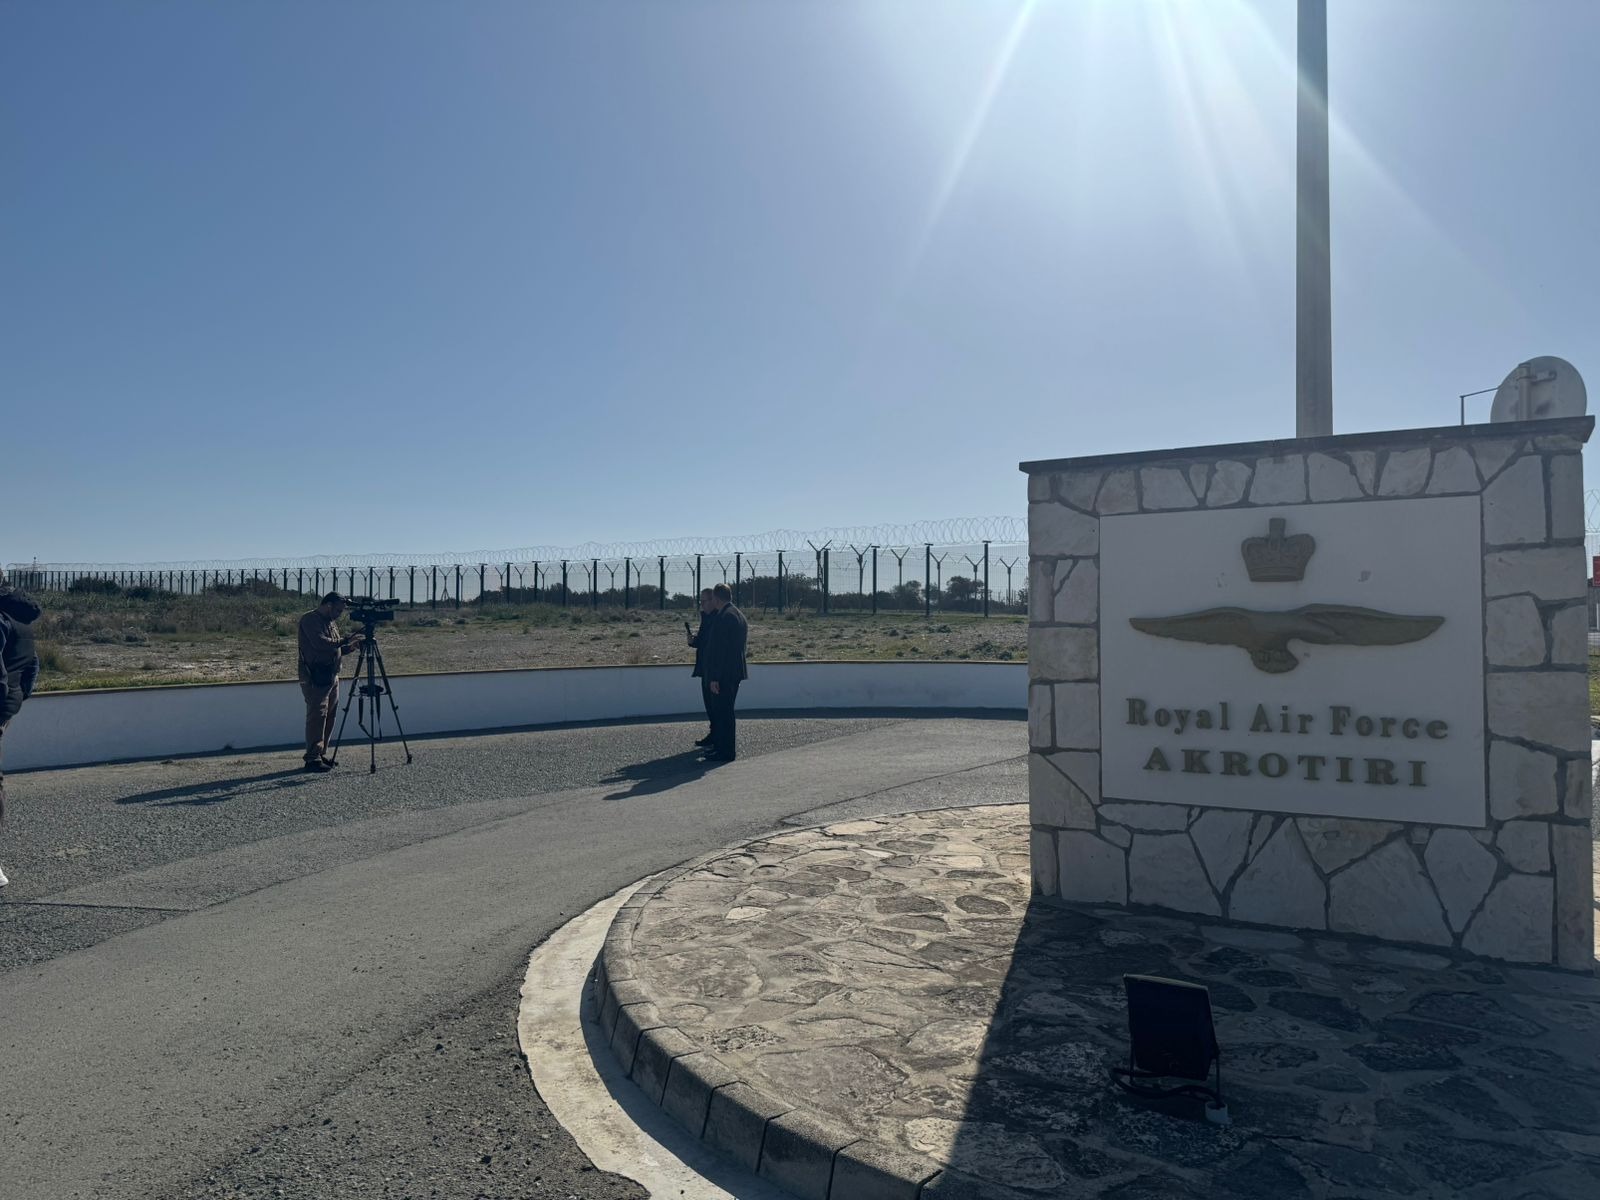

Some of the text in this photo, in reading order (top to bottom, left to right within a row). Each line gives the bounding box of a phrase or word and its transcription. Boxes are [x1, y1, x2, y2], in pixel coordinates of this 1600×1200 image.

[1126, 698, 1449, 740] Royal Air Force
[1143, 747, 1428, 787] AKROTIRI
